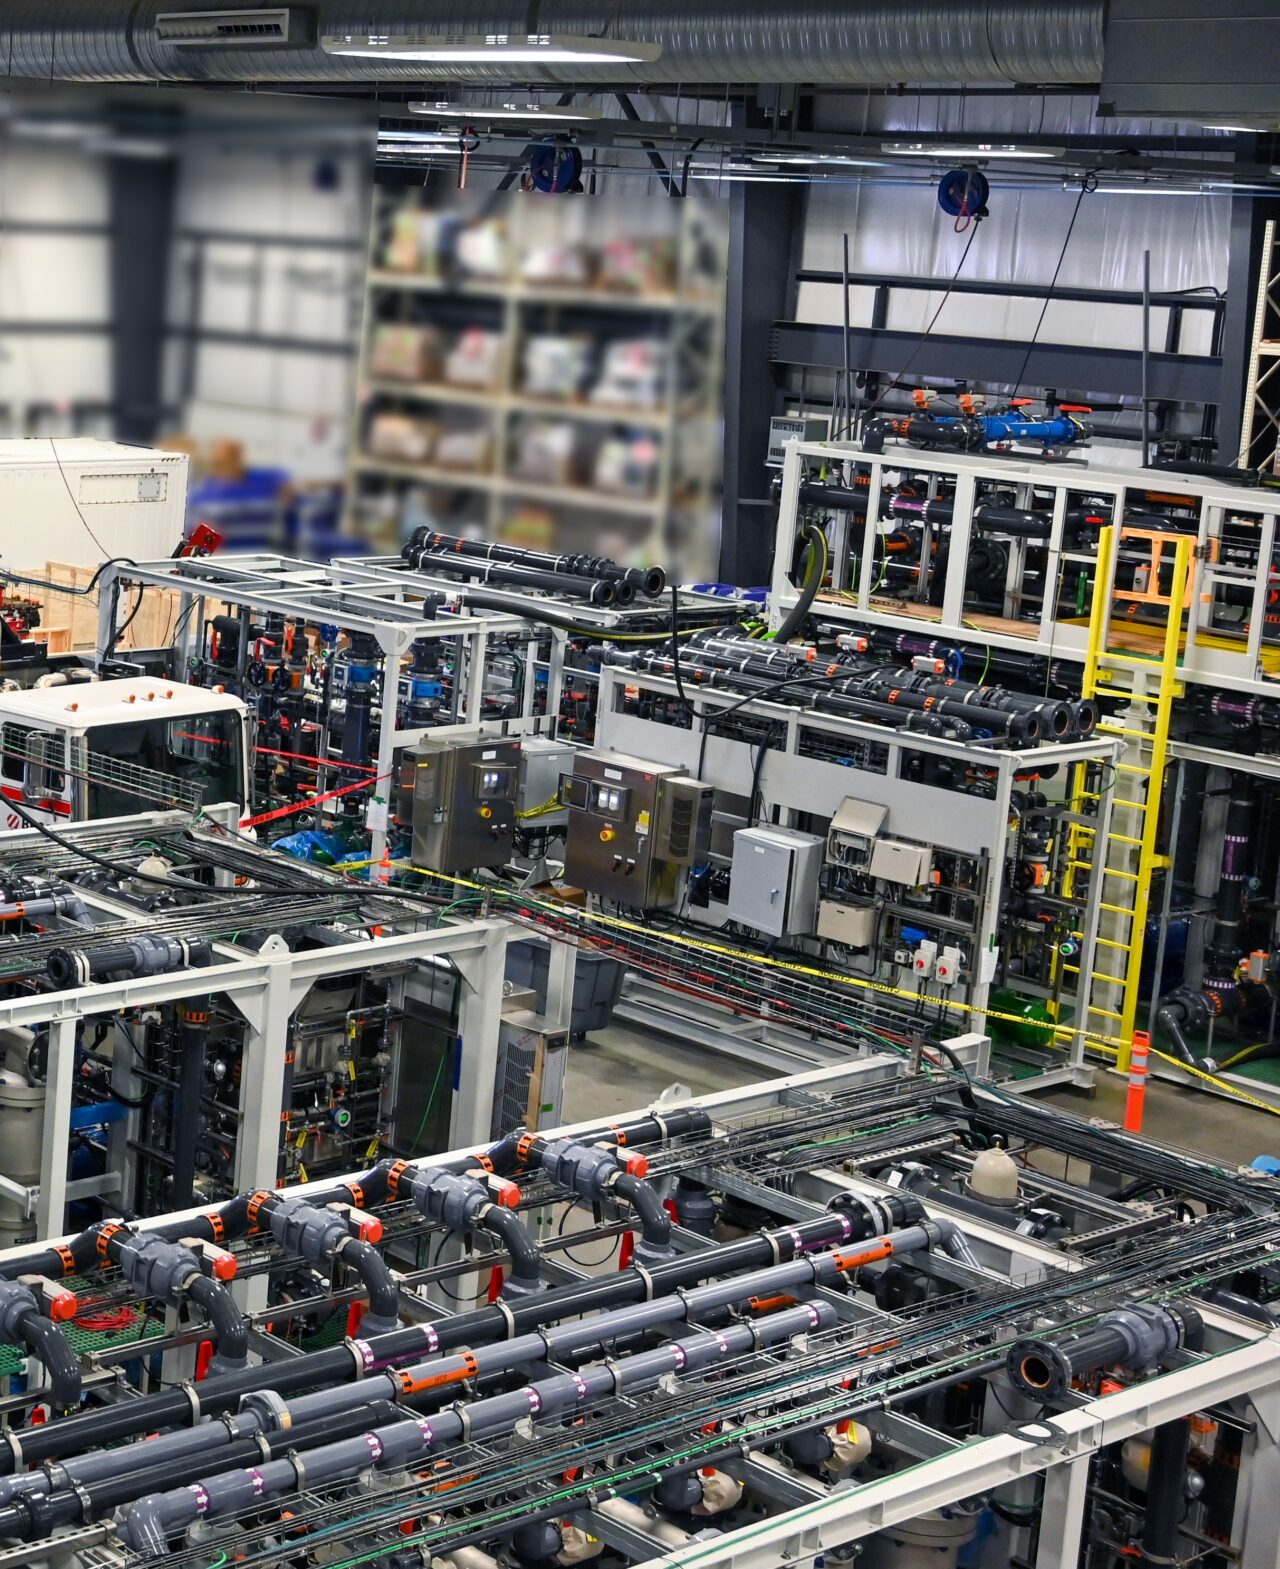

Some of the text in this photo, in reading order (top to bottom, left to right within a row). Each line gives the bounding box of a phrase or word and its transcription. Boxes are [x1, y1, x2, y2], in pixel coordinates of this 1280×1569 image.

[724, 948, 755, 959] CAUTION
[771, 959, 803, 970] CAUTION
[818, 970, 851, 982] CAUTION
[867, 981, 900, 994] CAUTION
[917, 993, 951, 1005] CAUTION
[969, 1005, 1004, 1017] CAUTION
